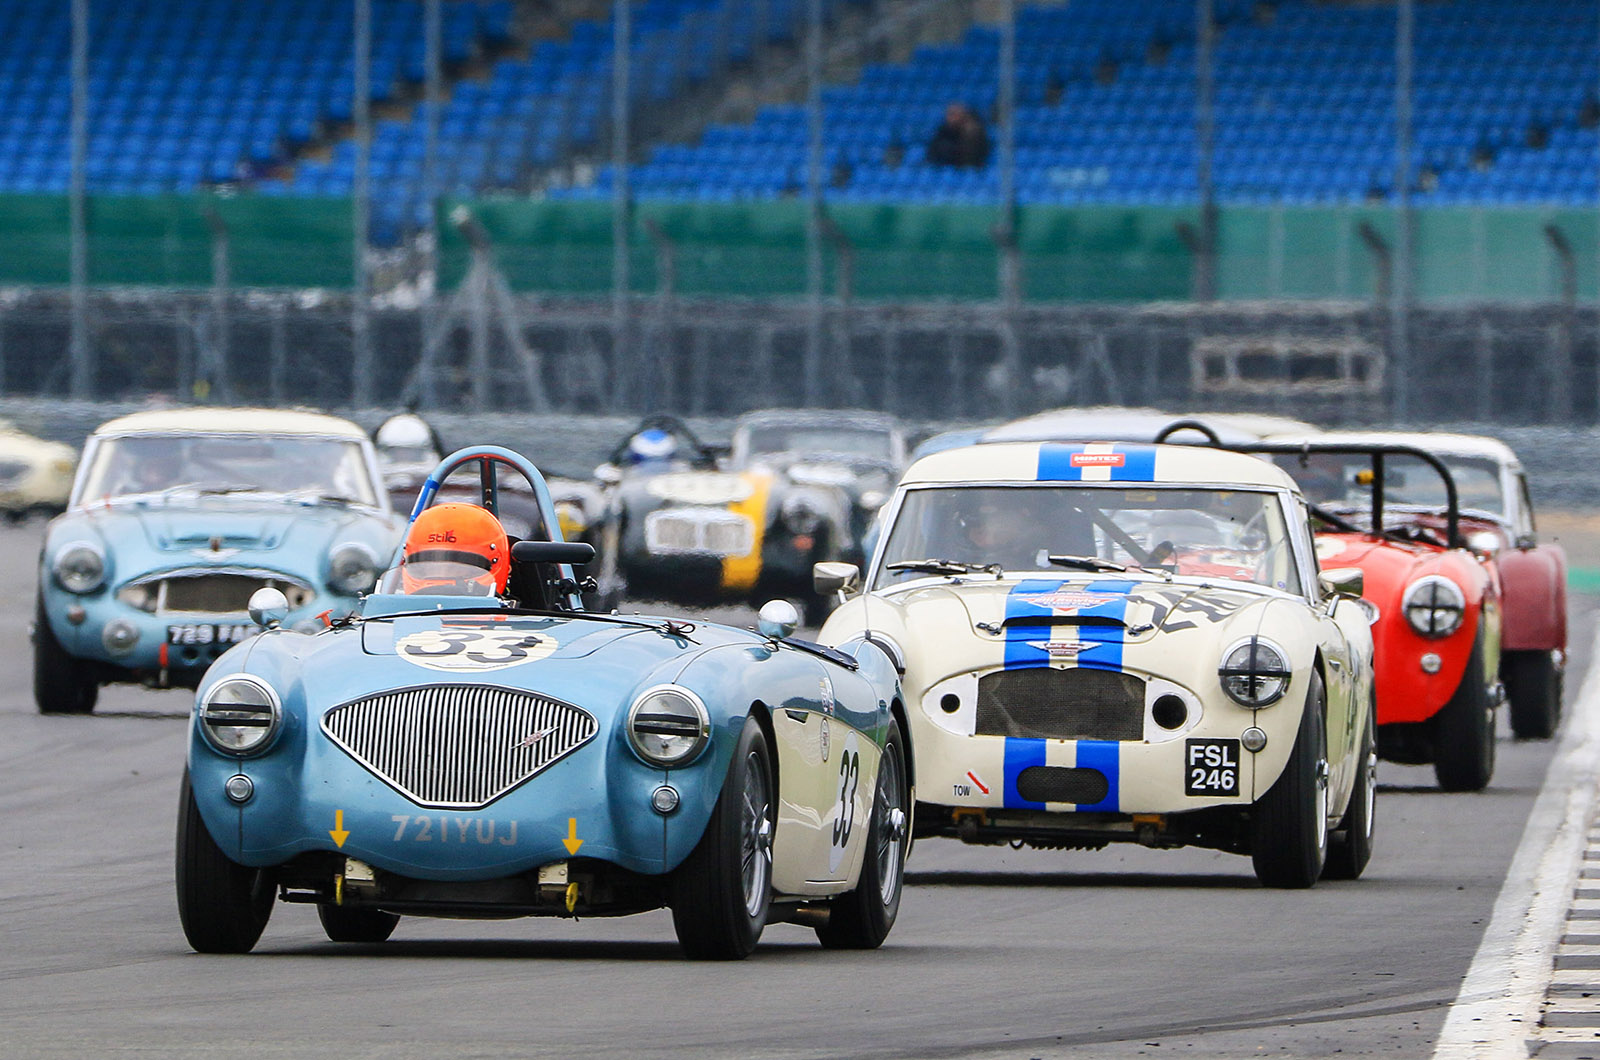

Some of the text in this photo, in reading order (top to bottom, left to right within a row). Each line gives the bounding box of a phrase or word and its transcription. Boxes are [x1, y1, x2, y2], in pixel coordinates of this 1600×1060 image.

[404, 632, 538, 663] 33
[1189, 745, 1237, 767] FSL
[1190, 768, 1235, 790] 246
[833, 749, 859, 848] 33
[953, 784, 971, 797] TOW
